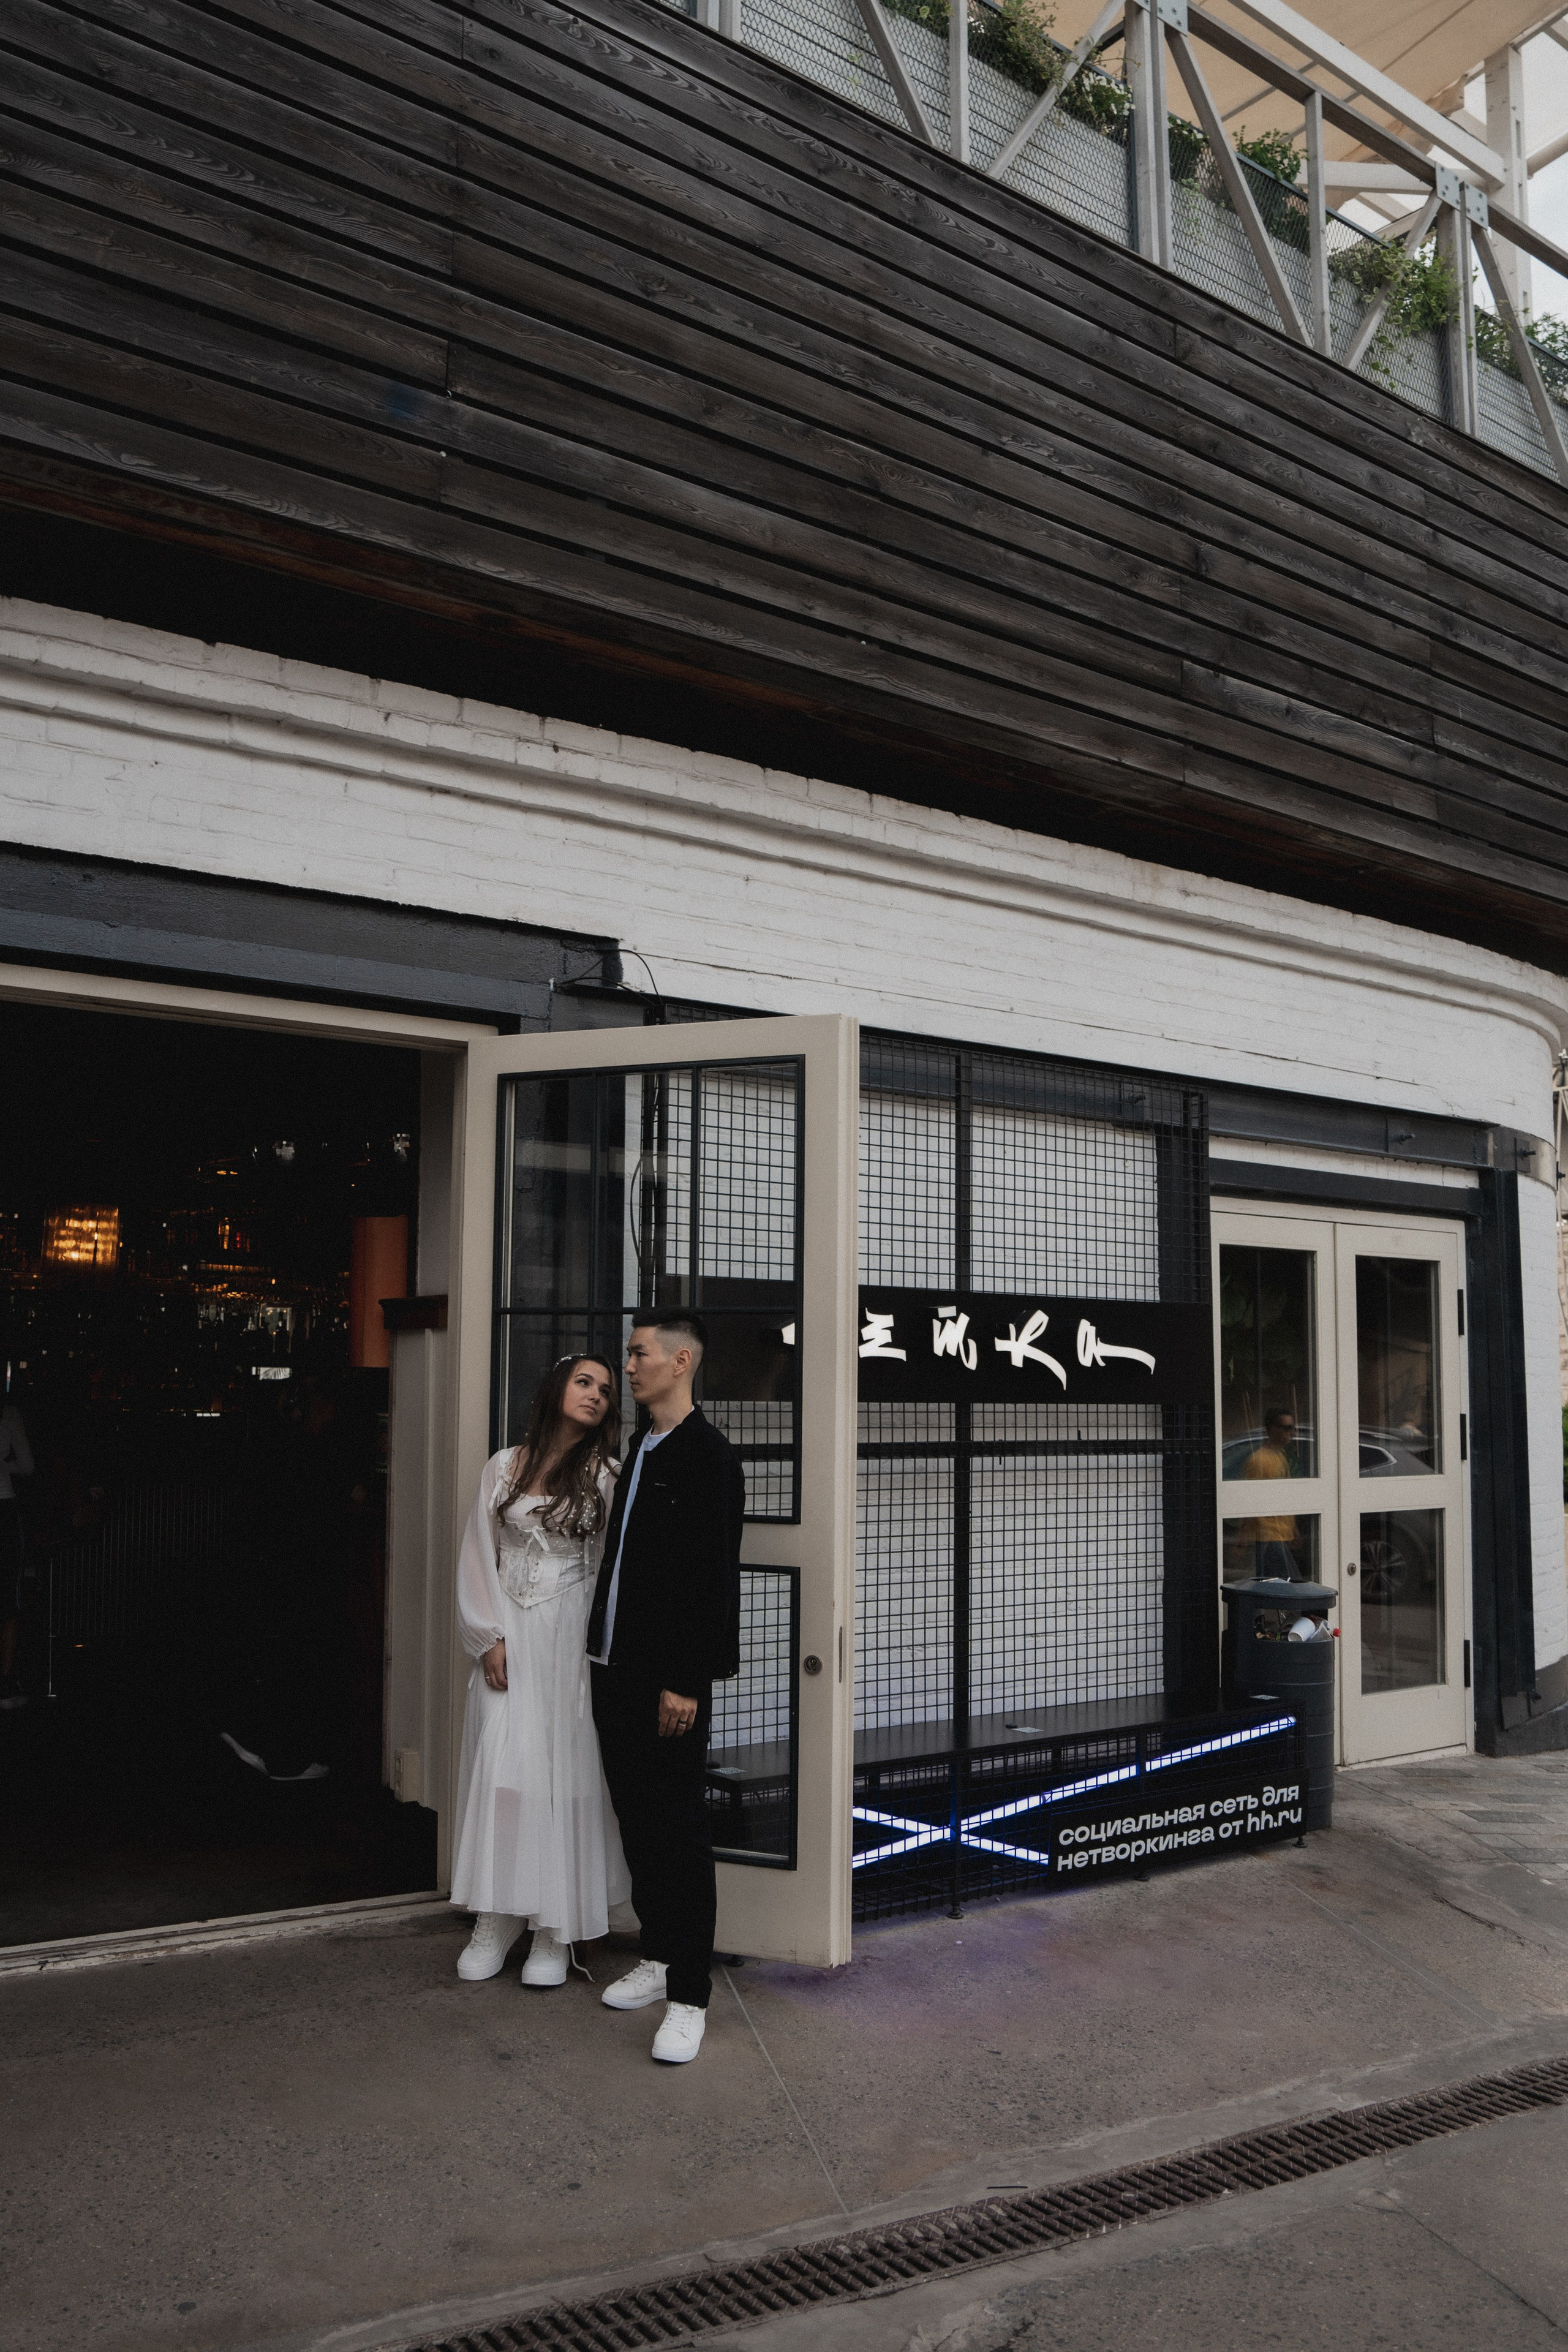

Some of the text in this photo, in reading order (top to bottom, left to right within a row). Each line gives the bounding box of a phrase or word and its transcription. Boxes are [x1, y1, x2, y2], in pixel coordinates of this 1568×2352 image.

[1057, 1807, 1303, 1872] нетворкинга от hh.ru
[1058, 1785, 1300, 1845] социальная сеть для
